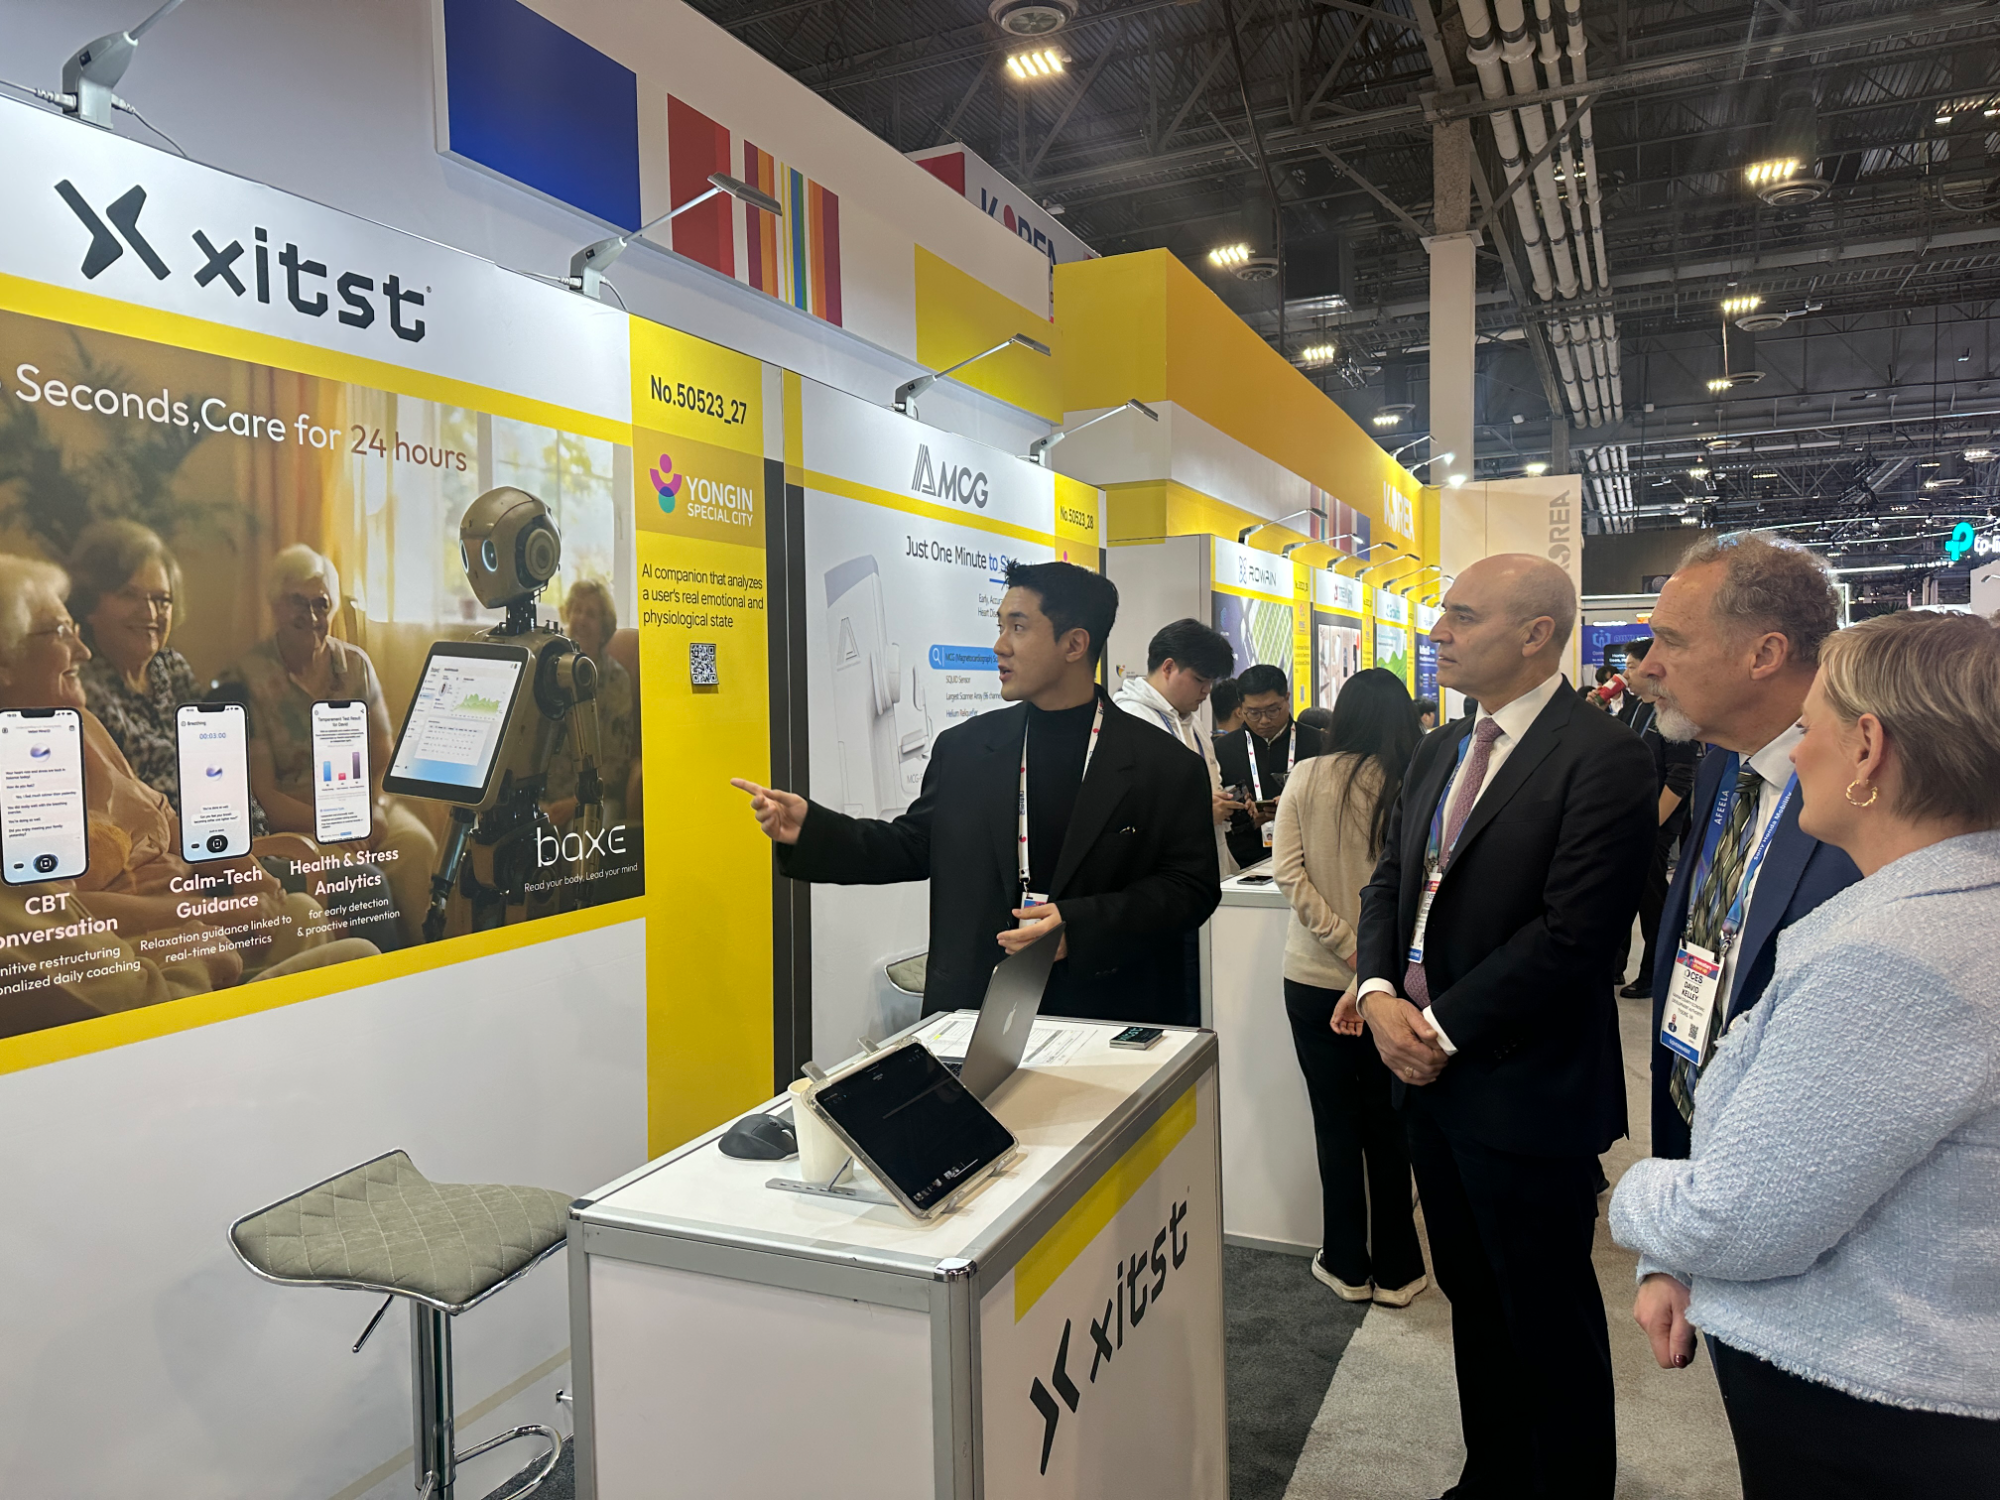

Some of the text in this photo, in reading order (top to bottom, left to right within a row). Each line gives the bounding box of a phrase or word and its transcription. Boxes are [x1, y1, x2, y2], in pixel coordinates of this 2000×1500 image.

[650, 374, 747, 425] No.50523_27
[294, 416, 342, 452] for
[350, 425, 388, 460] 24
[394, 433, 468, 473] hours
[685, 475, 753, 512] YONGIN
[687, 502, 753, 527] SPECIAL CITY
[1383, 480, 1415, 543] KOREA
[1547, 489, 1571, 570] OREA
[906, 536, 928, 560] Just
[931, 541, 952, 563] One
[955, 546, 987, 570] Minute
[989, 555, 999, 571] to
[642, 563, 763, 591] AI companion that analyzes
[1249, 565, 1276, 587] ROWAIN
[642, 588, 764, 610] a user's real emotional and
[643, 609, 733, 629] physiological state
[1714, 790, 1730, 825] AFEELA
[1754, 791, 1792, 860] Sony Honda Mobility
[289, 848, 399, 875] Health & Stress
[169, 865, 262, 894] Calm-Tech
[315, 874, 382, 896] Analytics
[524, 882, 545, 893] Read
[546, 877, 563, 891] your
[585, 870, 604, 882] Lead
[604, 867, 620, 880] your
[621, 863, 637, 875] mind
[25, 892, 70, 916] CBT
[176, 894, 259, 919] Guidance
[308, 897, 389, 919] for early detection
[0, 917, 118, 949] onversation
[140, 914, 292, 951] Relaxation guidance linked to
[297, 909, 400, 938] & proactive intervention
[0, 946, 121, 977] nitive restructuring
[165, 933, 272, 963] real-time biometrics
[0, 959, 141, 996] onalized daily coaching
[1683, 981, 1700, 994] DAVID
[1690, 972, 1703, 984] CES
[1681, 989, 1699, 1002] KELLEY
